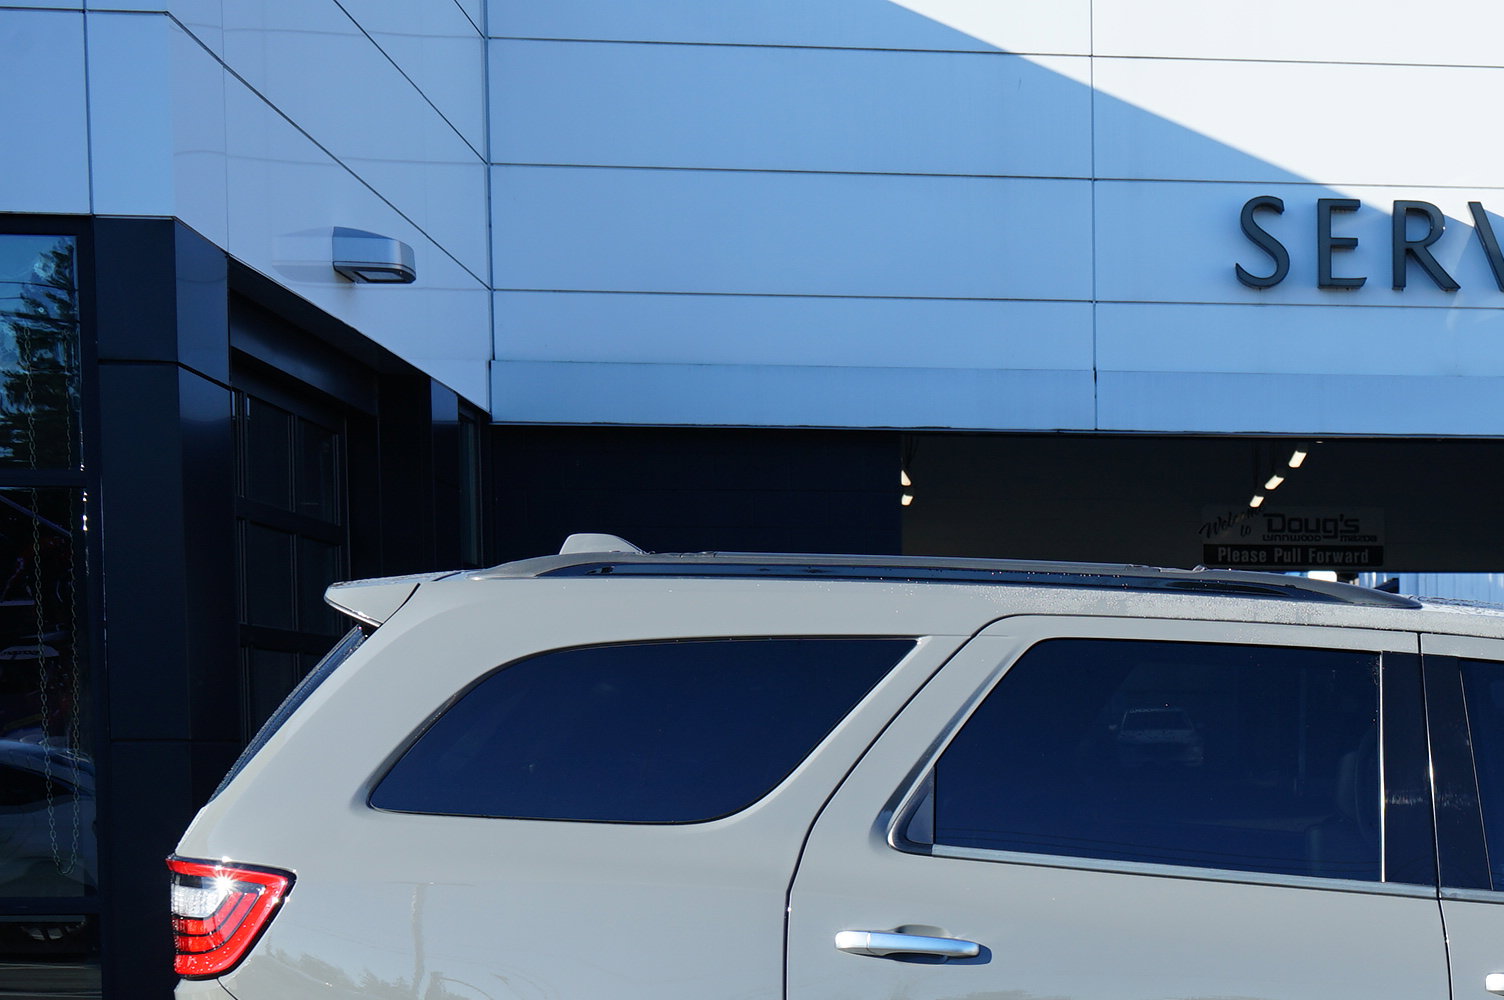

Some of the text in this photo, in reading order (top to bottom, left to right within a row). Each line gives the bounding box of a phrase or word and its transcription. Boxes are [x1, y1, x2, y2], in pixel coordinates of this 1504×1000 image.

[1263, 513, 1360, 539] Doug's
[1217, 546, 1369, 564] Please Pull Forward
